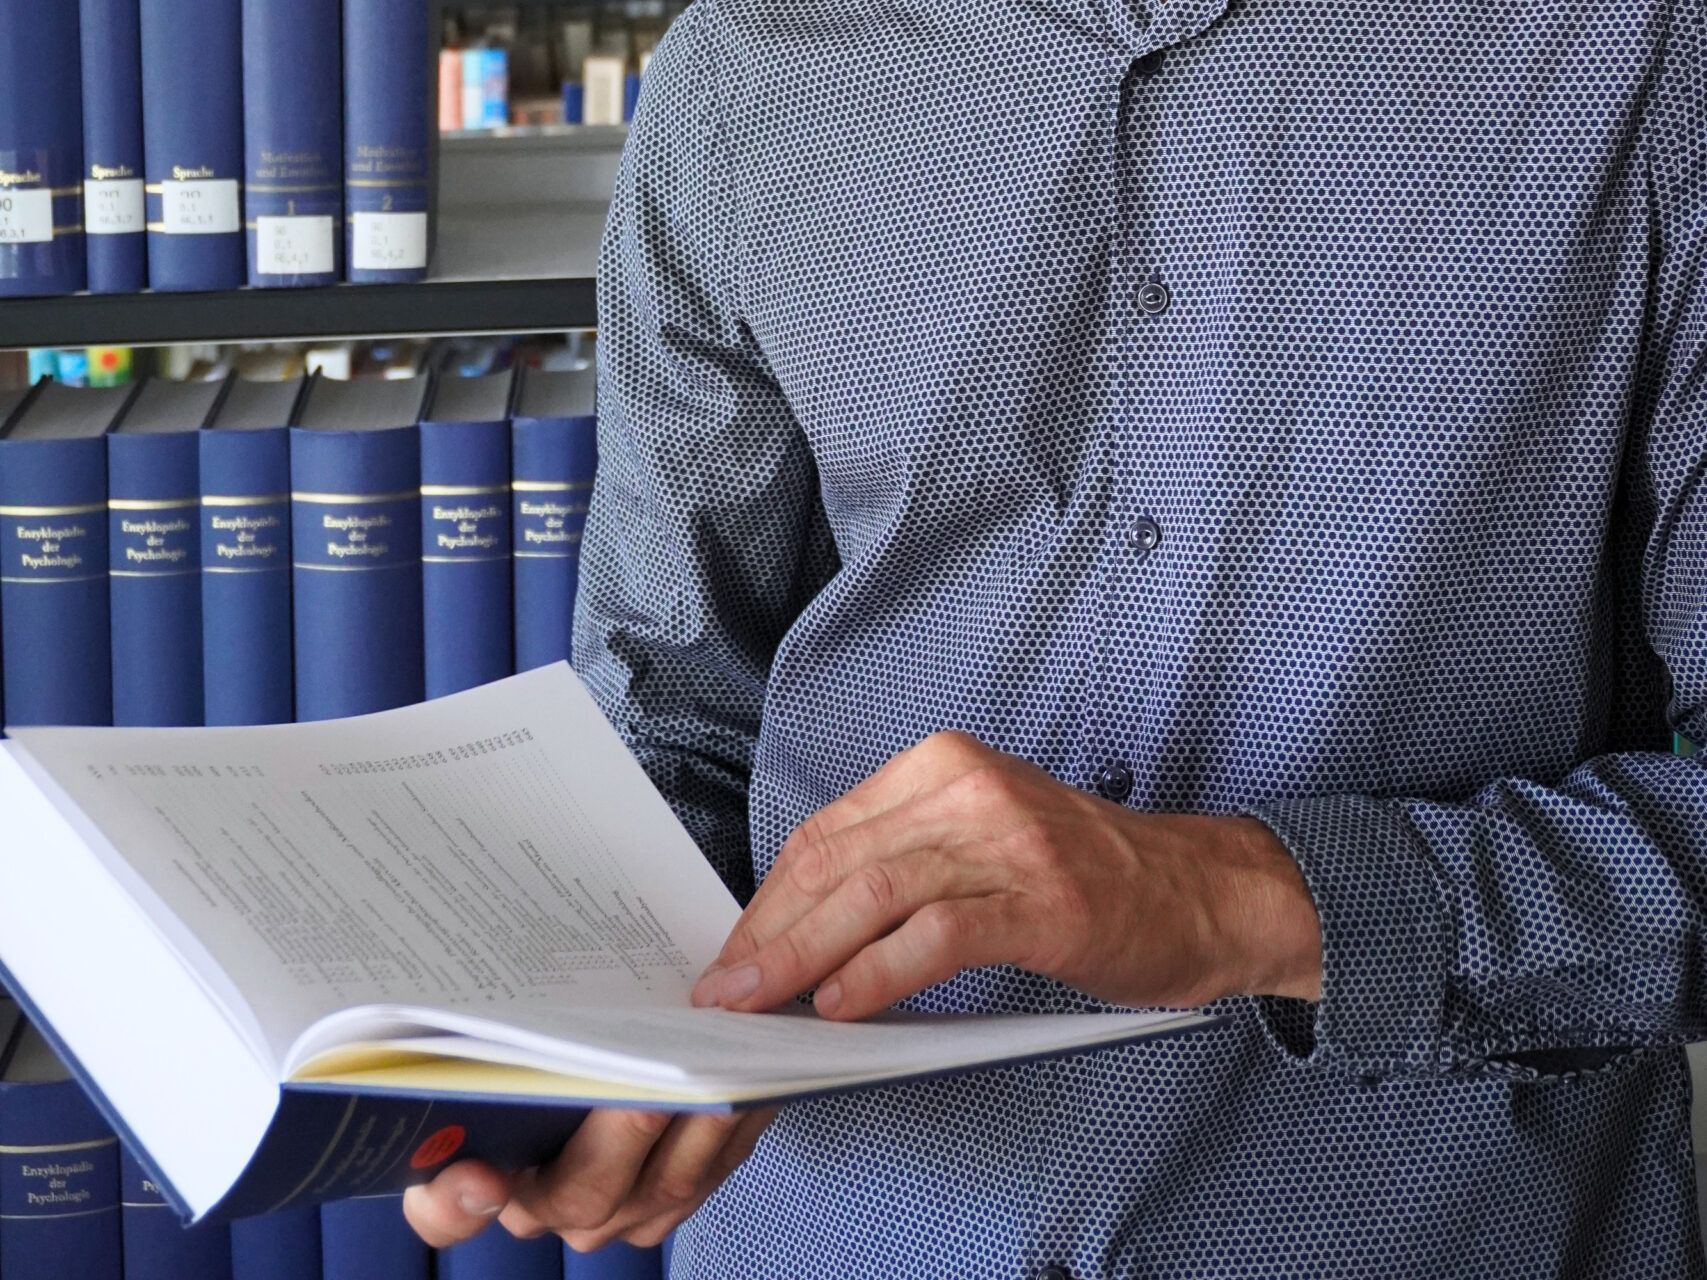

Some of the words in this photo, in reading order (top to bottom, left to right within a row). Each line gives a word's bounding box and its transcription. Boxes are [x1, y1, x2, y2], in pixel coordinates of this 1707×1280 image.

[92, 165, 133, 179] Sprache
[173, 165, 214, 181] Sprache
[382, 196, 392, 211] 2
[122, 520, 189, 533] Enzyklopädie
[212, 516, 279, 530] Enzyklopädie
[459, 522, 477, 532] der
[546, 517, 563, 528] der
[17, 526, 85, 539] Enzyklopädie
[237, 531, 255, 542] der
[349, 531, 367, 542] der
[42, 542, 60, 553] der
[147, 536, 164, 546] der
[437, 535, 498, 549] Psychologie
[126, 548, 186, 563] Psychologie
[217, 544, 276, 559] Psychologie
[327, 542, 388, 558] Psychologie
[22, 554, 82, 570] Psychologie
[22, 1161, 94, 1178] Enzyklopädie
[50, 1179, 66, 1189] der
[27, 1189, 90, 1205] Psychologie
